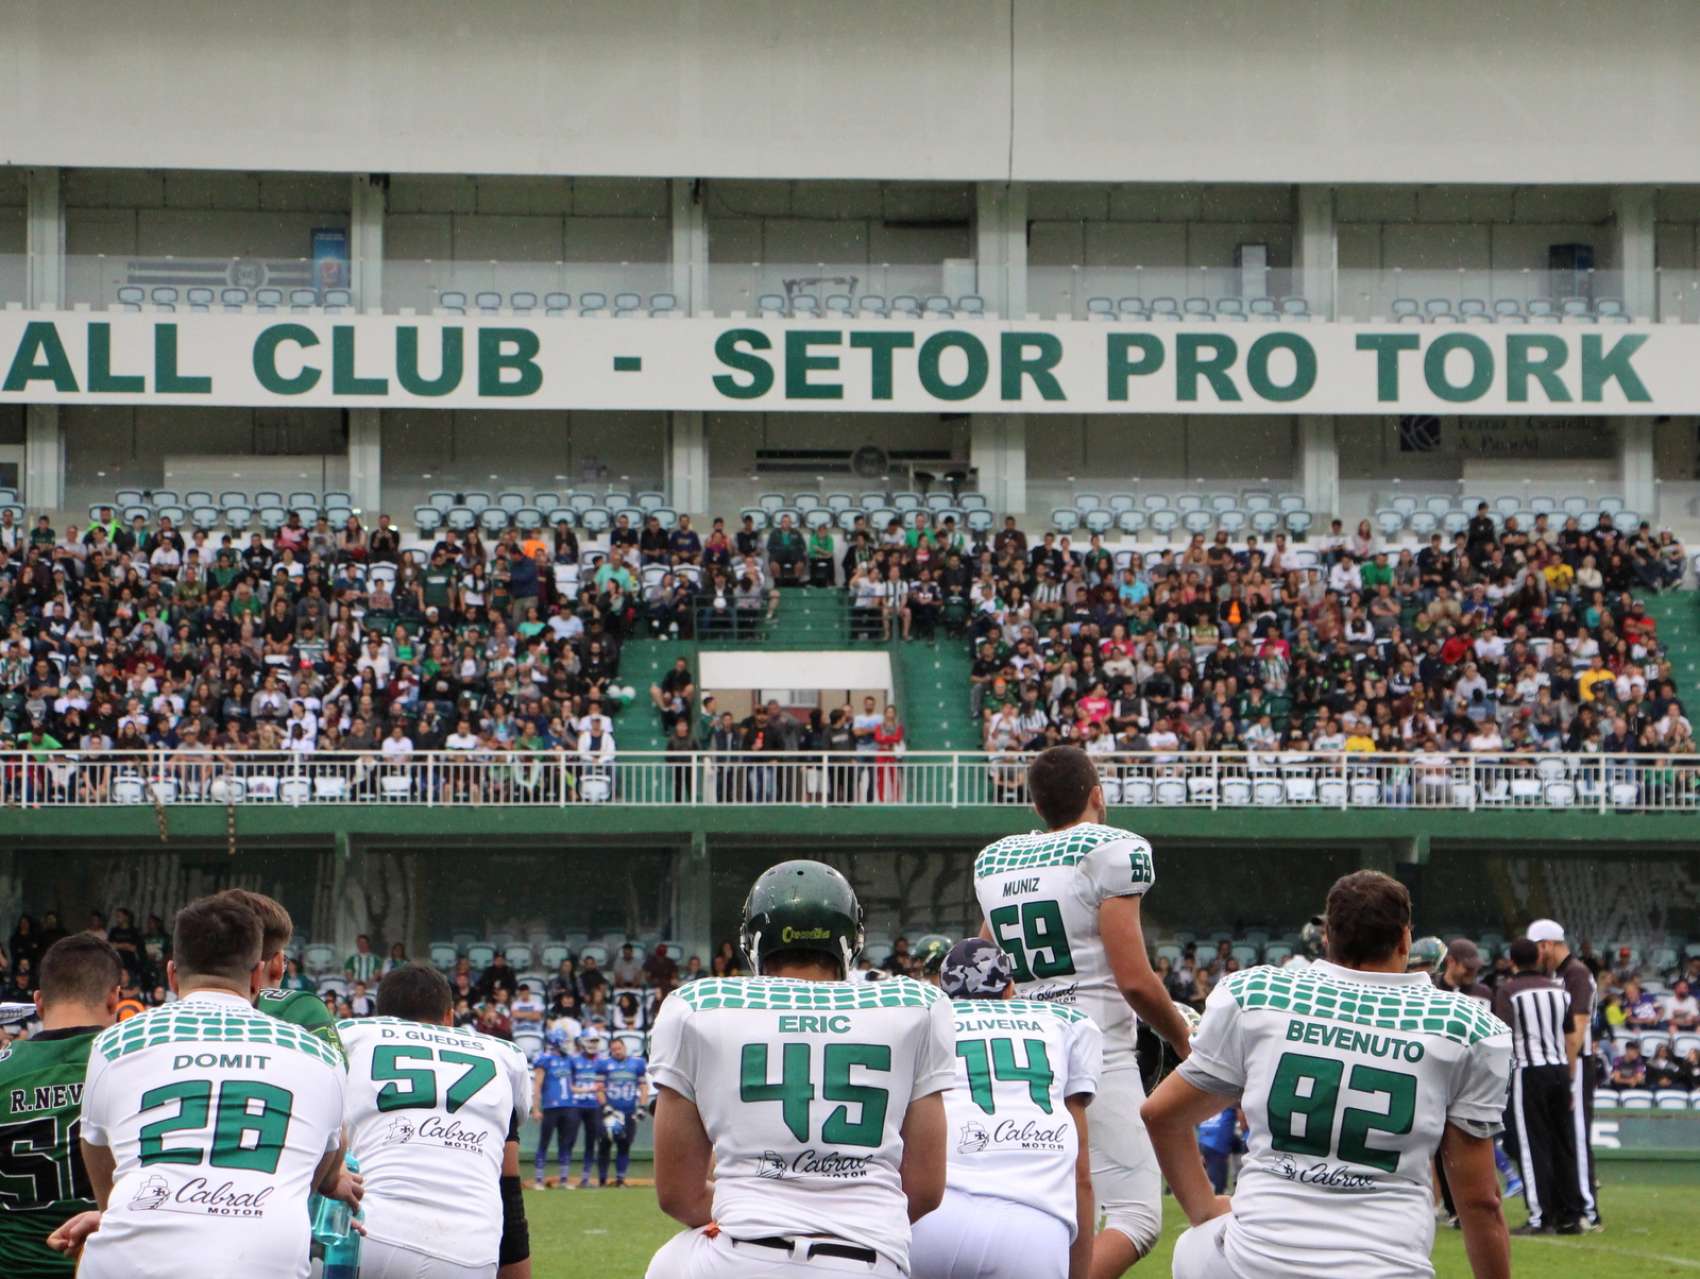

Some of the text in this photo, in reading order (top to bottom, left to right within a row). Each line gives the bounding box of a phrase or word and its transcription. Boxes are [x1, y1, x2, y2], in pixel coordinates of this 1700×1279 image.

[2, 321, 212, 394] ALL
[252, 323, 544, 397] CLUB
[711, 328, 1068, 401] SETOR
[1106, 331, 1318, 403] PRO
[1355, 332, 1654, 404] TORK
[1002, 877, 1041, 897] MUNIZ
[990, 899, 1077, 984] 59
[381, 1029, 485, 1051] D. GUEDES
[778, 1015, 851, 1034] ERIC
[1286, 1019, 1425, 1064] BEVENUTO
[172, 1053, 272, 1071] DOMIT
[955, 1038, 1055, 1116] 14
[371, 1044, 497, 1114] 57
[739, 1042, 892, 1148] 45
[138, 1079, 294, 1175] 28
[1267, 1052, 1418, 1173] 82
[418, 1116, 489, 1146] Cabral
[994, 1119, 1069, 1143] Cabral
[1021, 1142, 1065, 1150] MOTOR
[175, 1177, 275, 1208] Cabral
[208, 1207, 263, 1217] MOTOR
